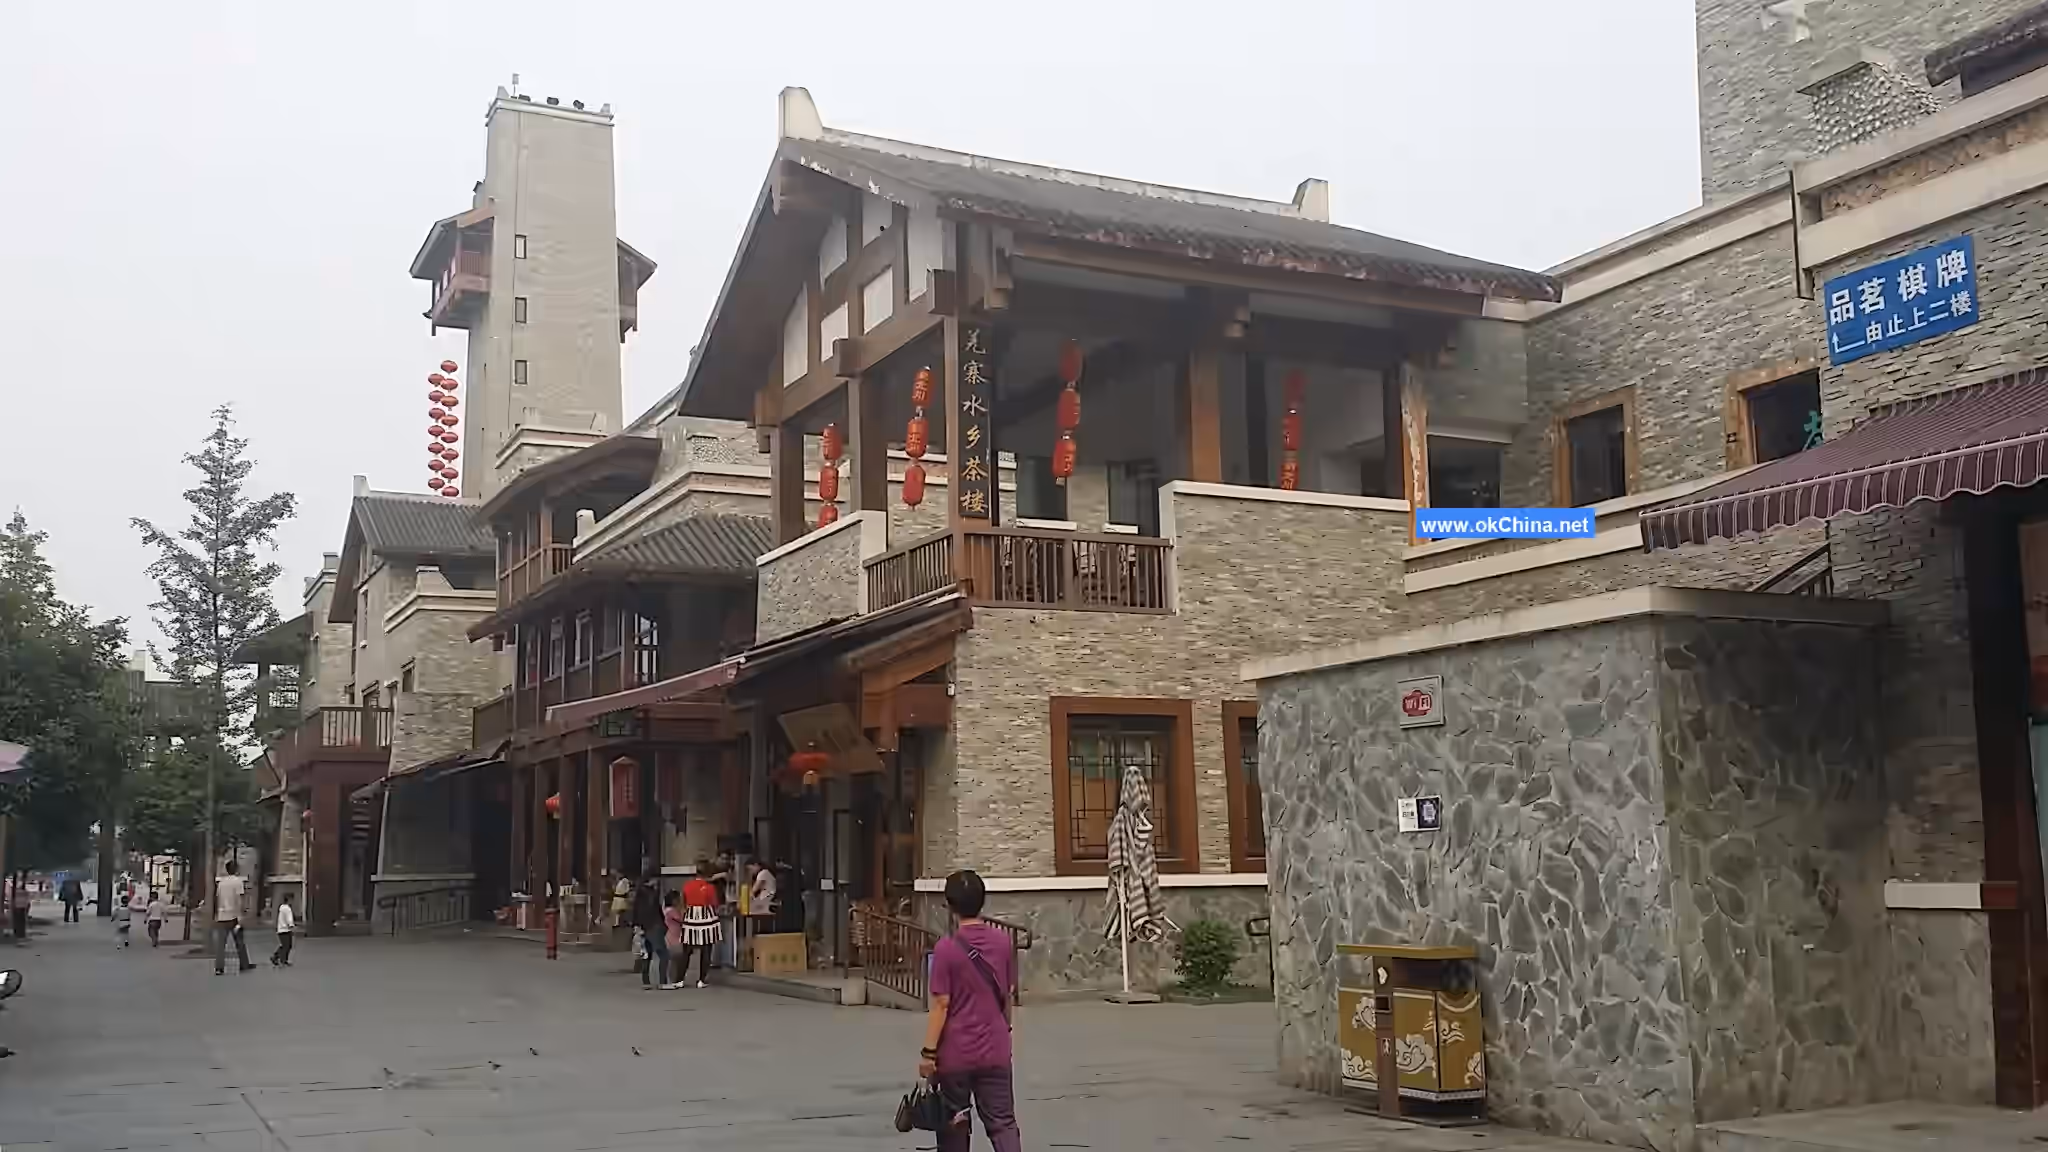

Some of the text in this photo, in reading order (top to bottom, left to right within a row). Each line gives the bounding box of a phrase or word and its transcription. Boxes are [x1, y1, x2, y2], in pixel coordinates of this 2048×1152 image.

[1829, 250, 1968, 326] 品茗棋牌
[1865, 290, 1972, 344] 由止上二楼
[960, 328, 988, 513] 羌寨水乡茶楼
